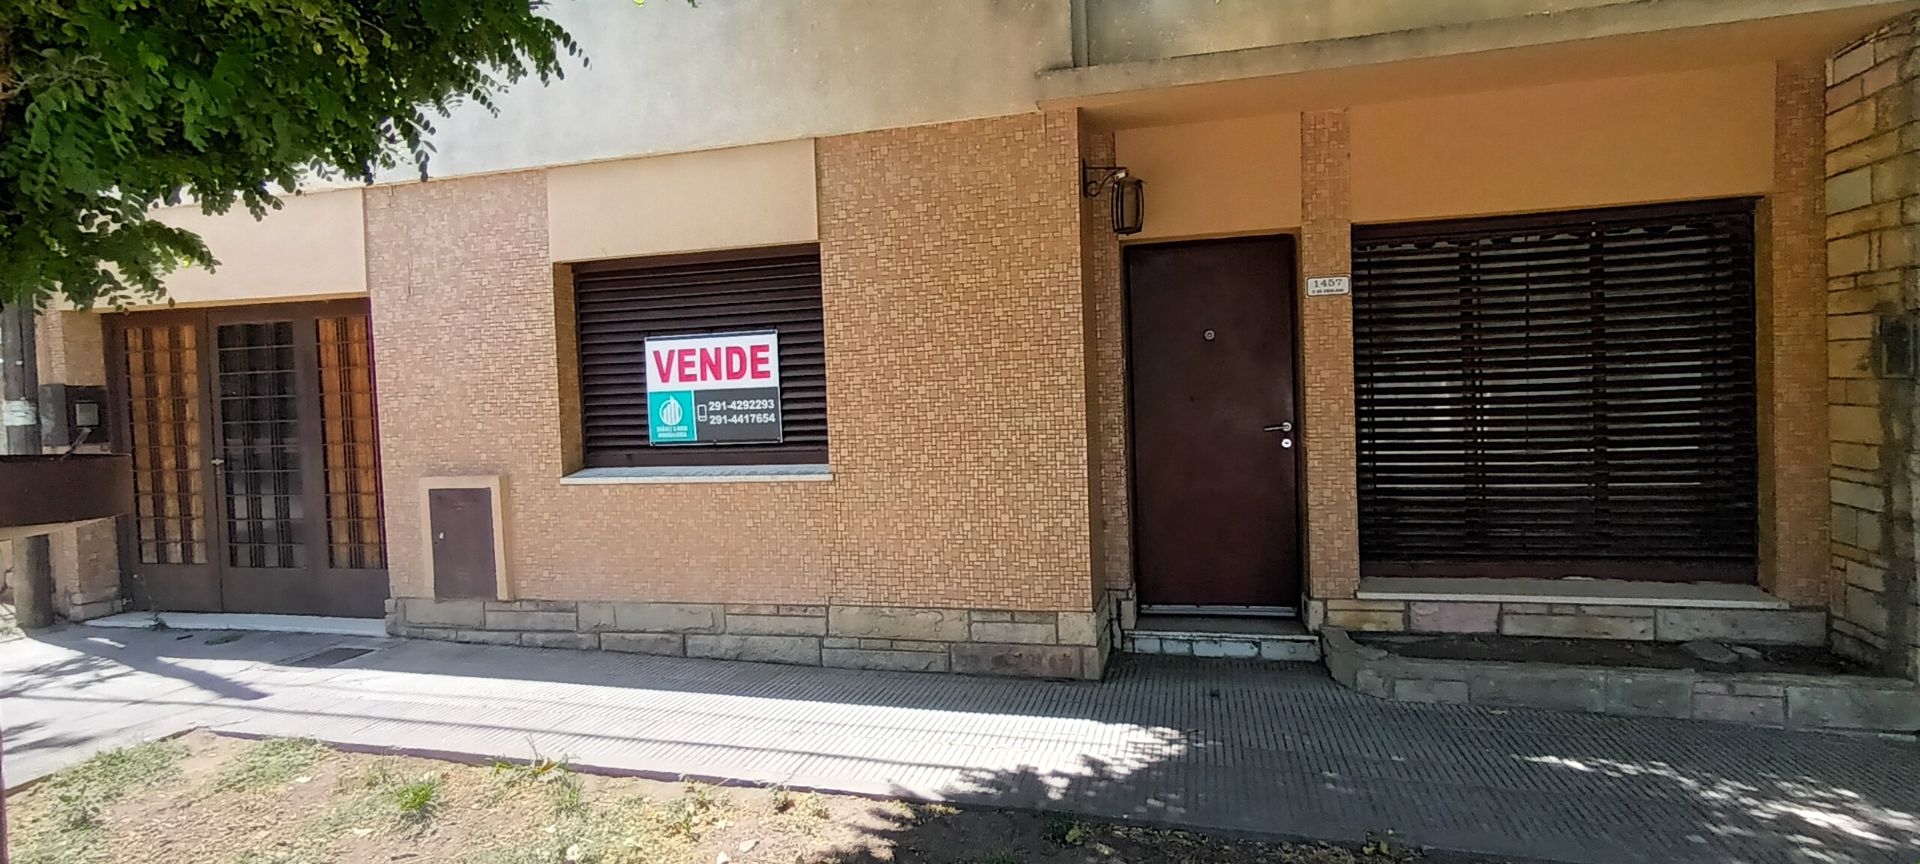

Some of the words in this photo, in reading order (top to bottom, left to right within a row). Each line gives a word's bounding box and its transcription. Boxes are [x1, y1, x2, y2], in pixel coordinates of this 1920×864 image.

[652, 344, 771, 384] VENDE
[708, 399, 775, 411] 291-4292293
[709, 412, 776, 425] 291-4417654
